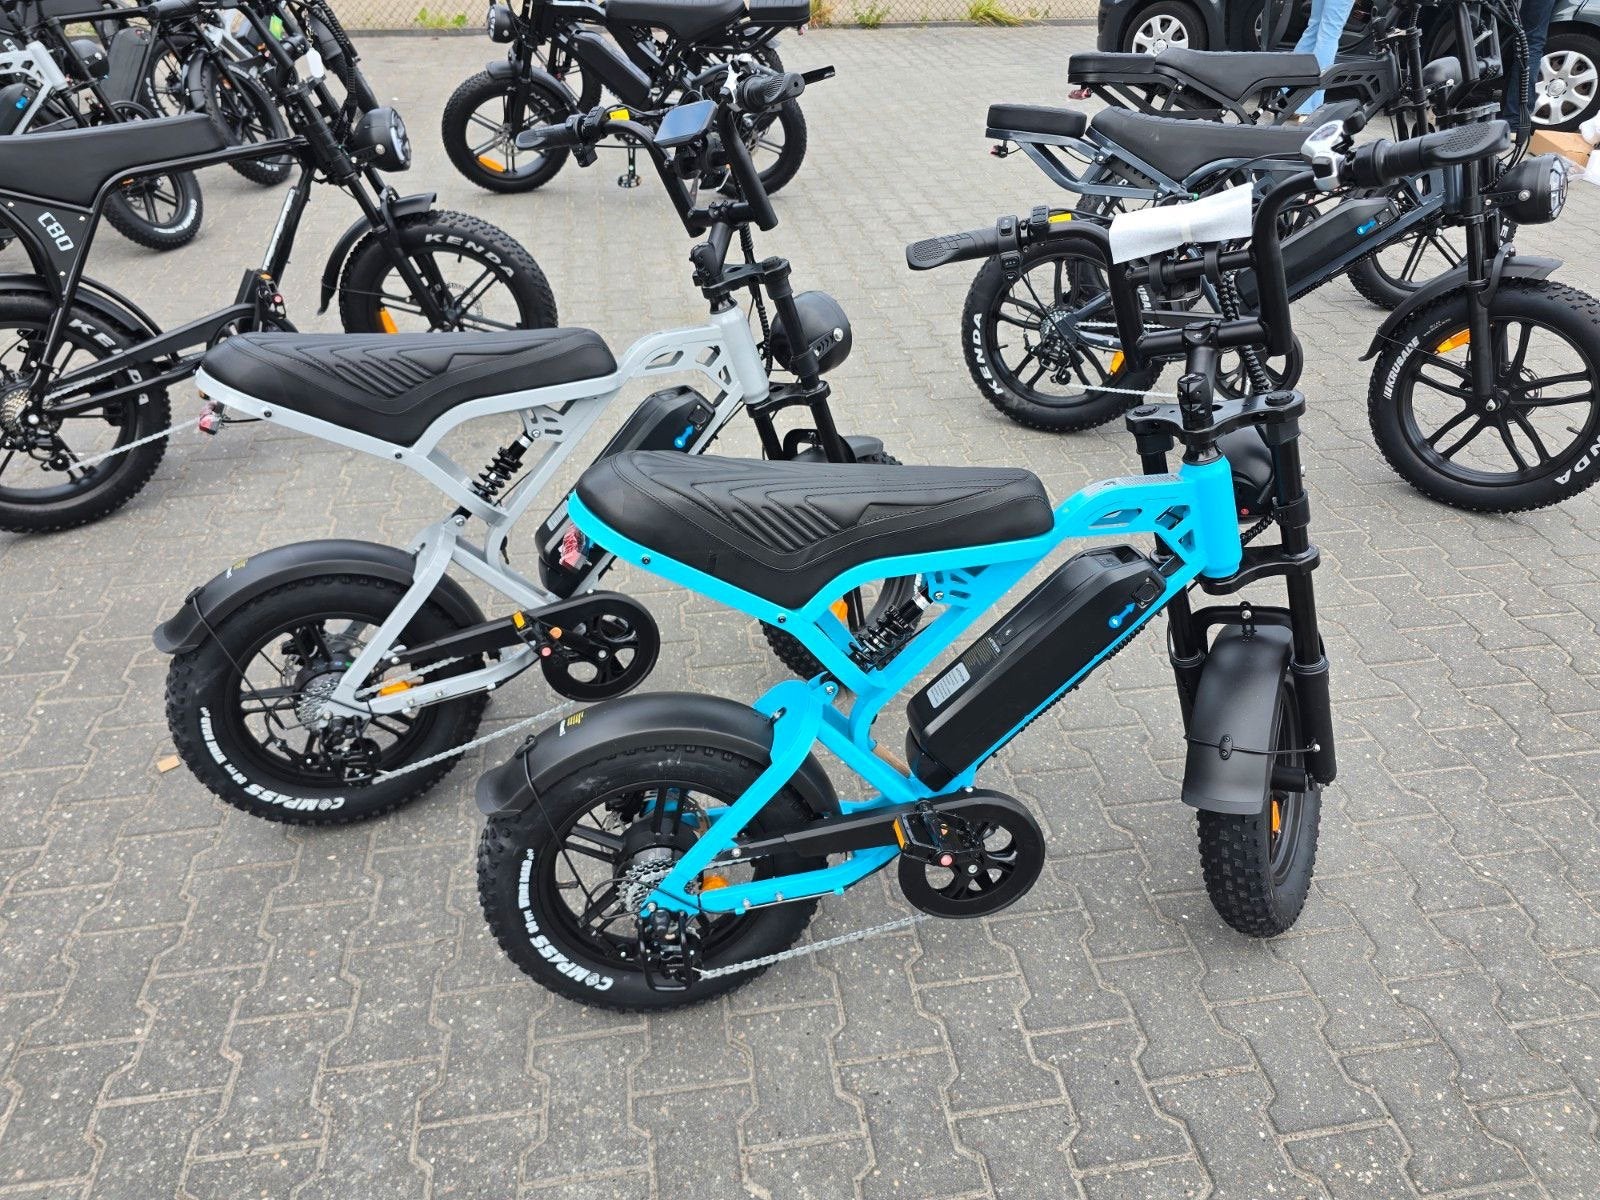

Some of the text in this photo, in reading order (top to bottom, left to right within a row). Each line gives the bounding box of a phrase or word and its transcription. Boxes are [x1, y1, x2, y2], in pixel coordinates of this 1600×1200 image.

[37, 211, 75, 252] C80
[425, 233, 515, 278] KENDA
[68, 318, 150, 406] KEDA
[972, 313, 1004, 395] KENDA
[243, 783, 346, 812] COMPASS
[529, 934, 614, 991] COMPASS
